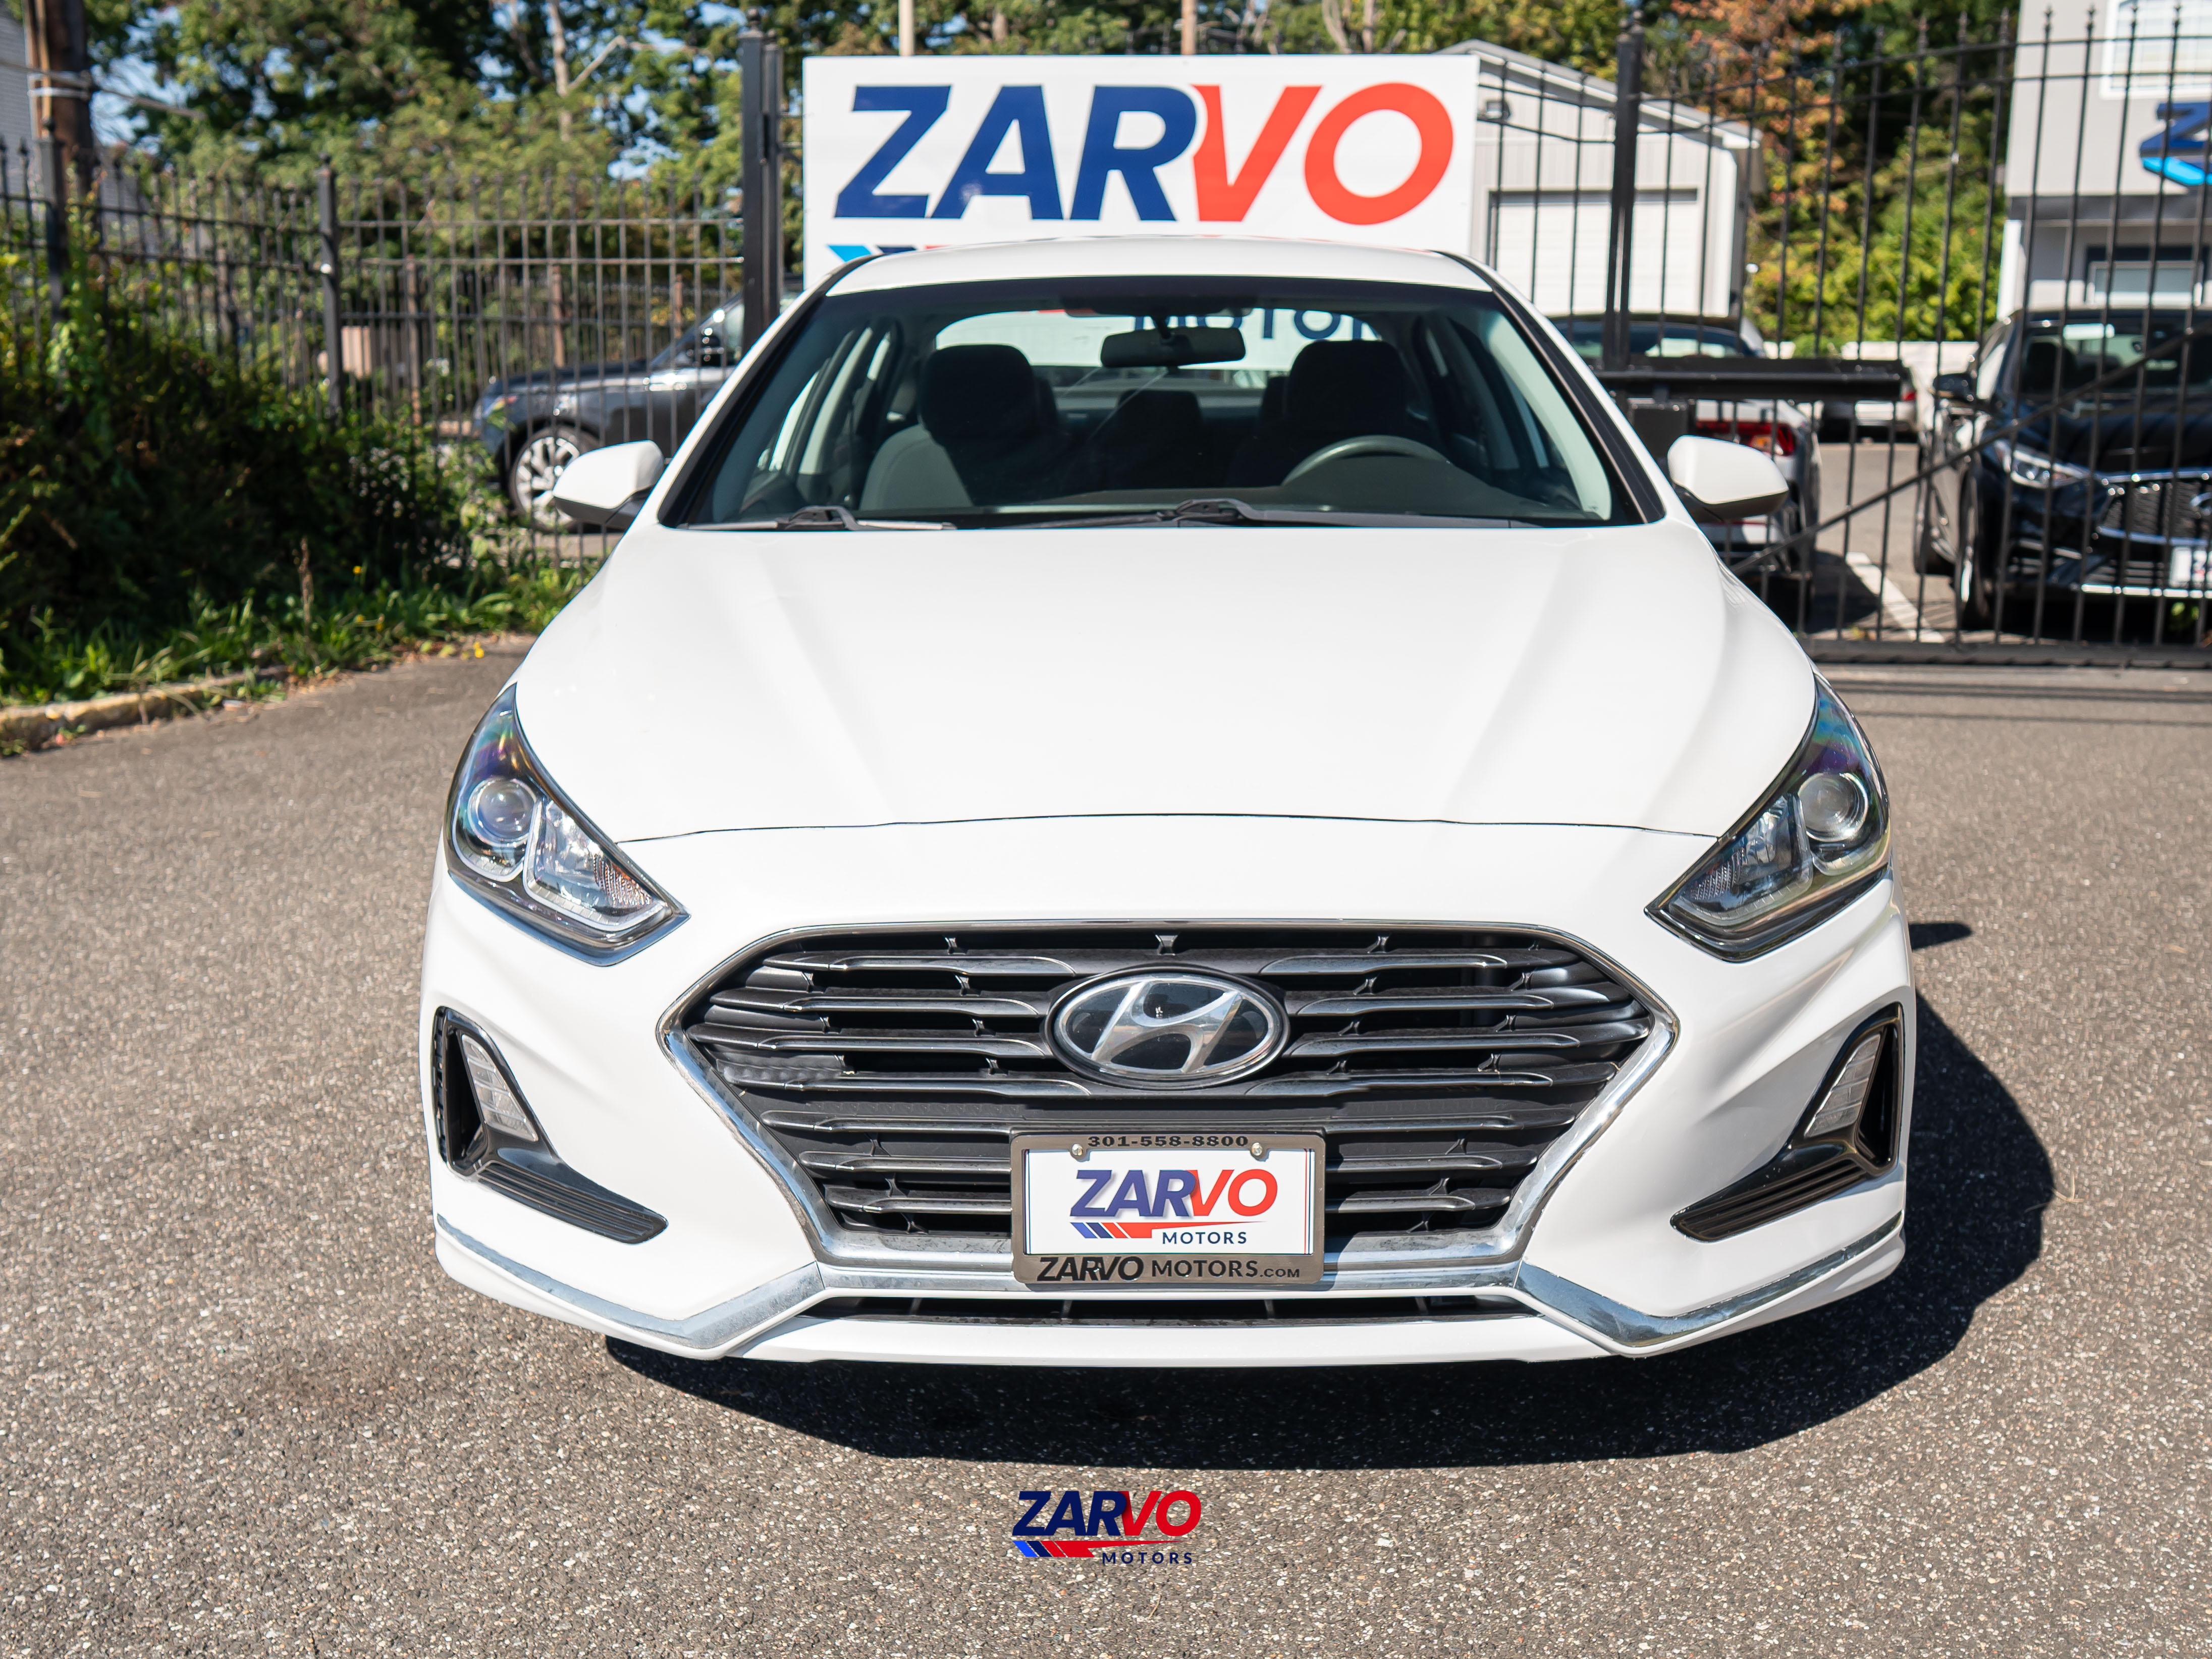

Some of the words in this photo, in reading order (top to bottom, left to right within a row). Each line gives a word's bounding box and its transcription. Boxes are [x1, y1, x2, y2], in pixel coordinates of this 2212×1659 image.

[833, 81, 1454, 226] ZARVO
[1087, 1135, 1249, 1148] 301-558-8800
[1069, 1168, 1278, 1217] ZARVO
[1162, 1231, 1248, 1245] MOTORS
[1036, 1256, 1144, 1282] ZARVO
